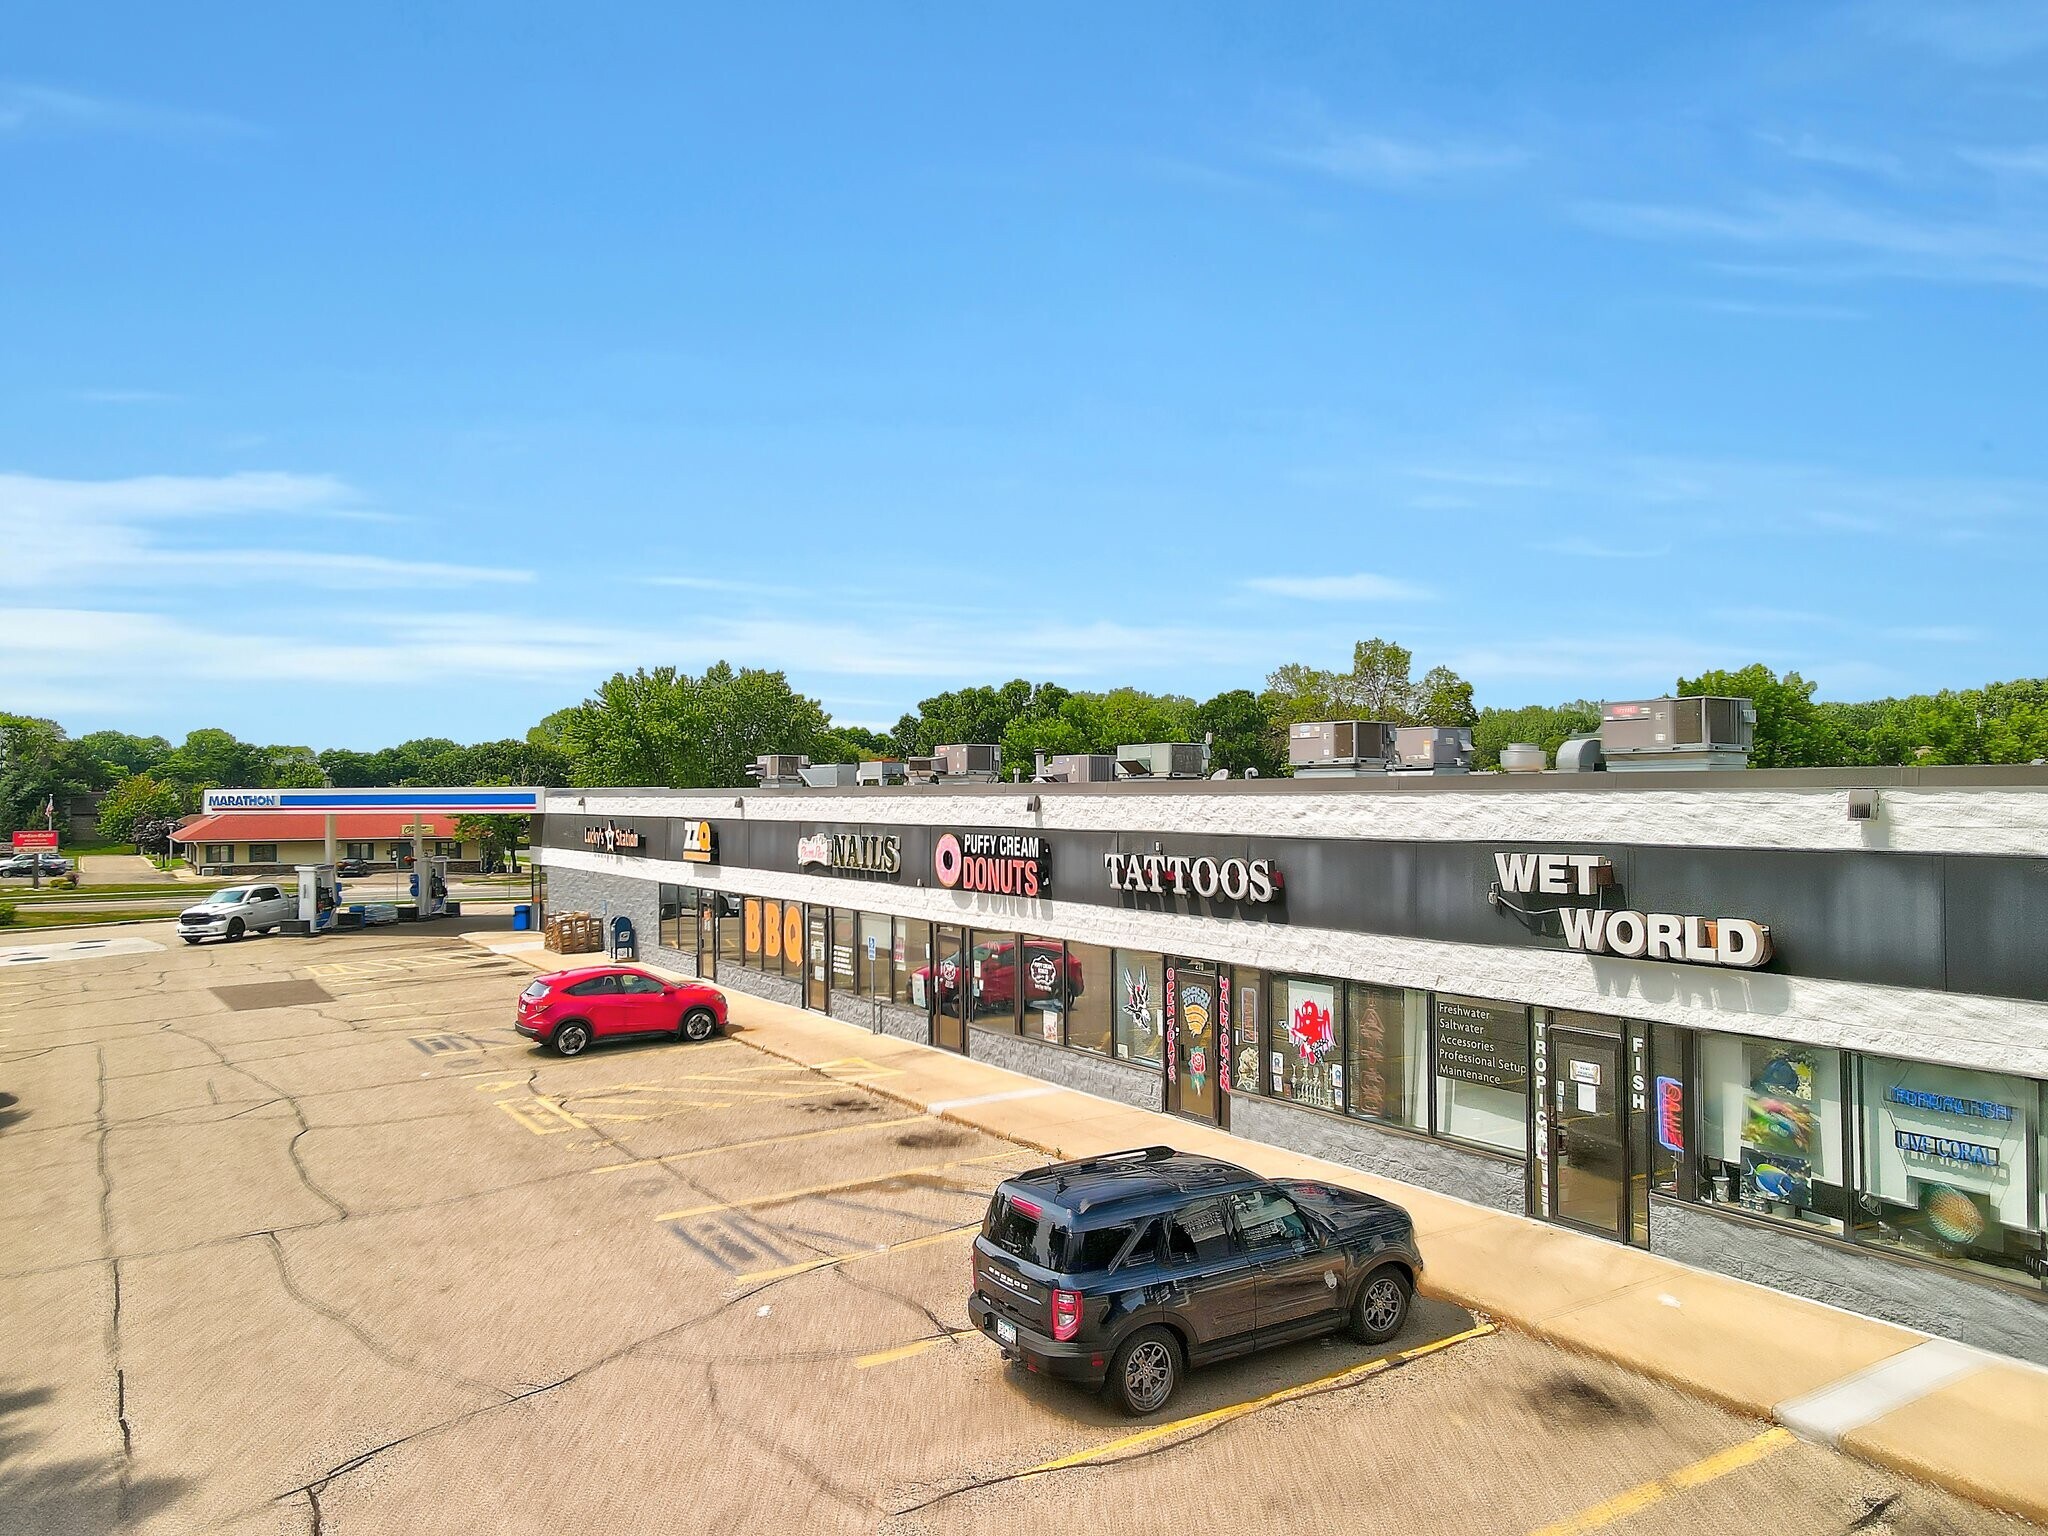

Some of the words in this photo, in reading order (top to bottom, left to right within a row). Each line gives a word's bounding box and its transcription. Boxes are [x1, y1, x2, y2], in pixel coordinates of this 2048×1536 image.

[208, 795, 275, 807] MARATHON
[584, 827, 605, 848] Lucky's
[615, 829, 639, 848] Station
[832, 833, 899, 873] NAILS
[964, 833, 997, 857] PUFFY
[999, 835, 1040, 858] CREAM
[962, 856, 1038, 896] DONUTS
[1104, 852, 1273, 903] TATTOOS
[1495, 853, 1603, 895] WET
[745, 899, 803, 968] BBQ
[1559, 907, 1764, 967] WORLD
[1166, 967, 1175, 1017] OPEN
[1439, 1003, 1490, 1020] Freshwater
[1439, 1018, 1484, 1035] Saltwater
[1439, 1034, 1495, 1053] Accessories
[1439, 1048, 1496, 1068] Professional
[1498, 1059, 1527, 1076] Setup
[1439, 1064, 1501, 1085] Maintenance
[1535, 1022, 1548, 1160] TROPICAL
[1632, 1037, 1645, 1111] FISH
[1897, 1130, 1932, 1154] LIVE
[1936, 1138, 1995, 1167] CORAL
[988, 1266, 1029, 1291] BRONCO
